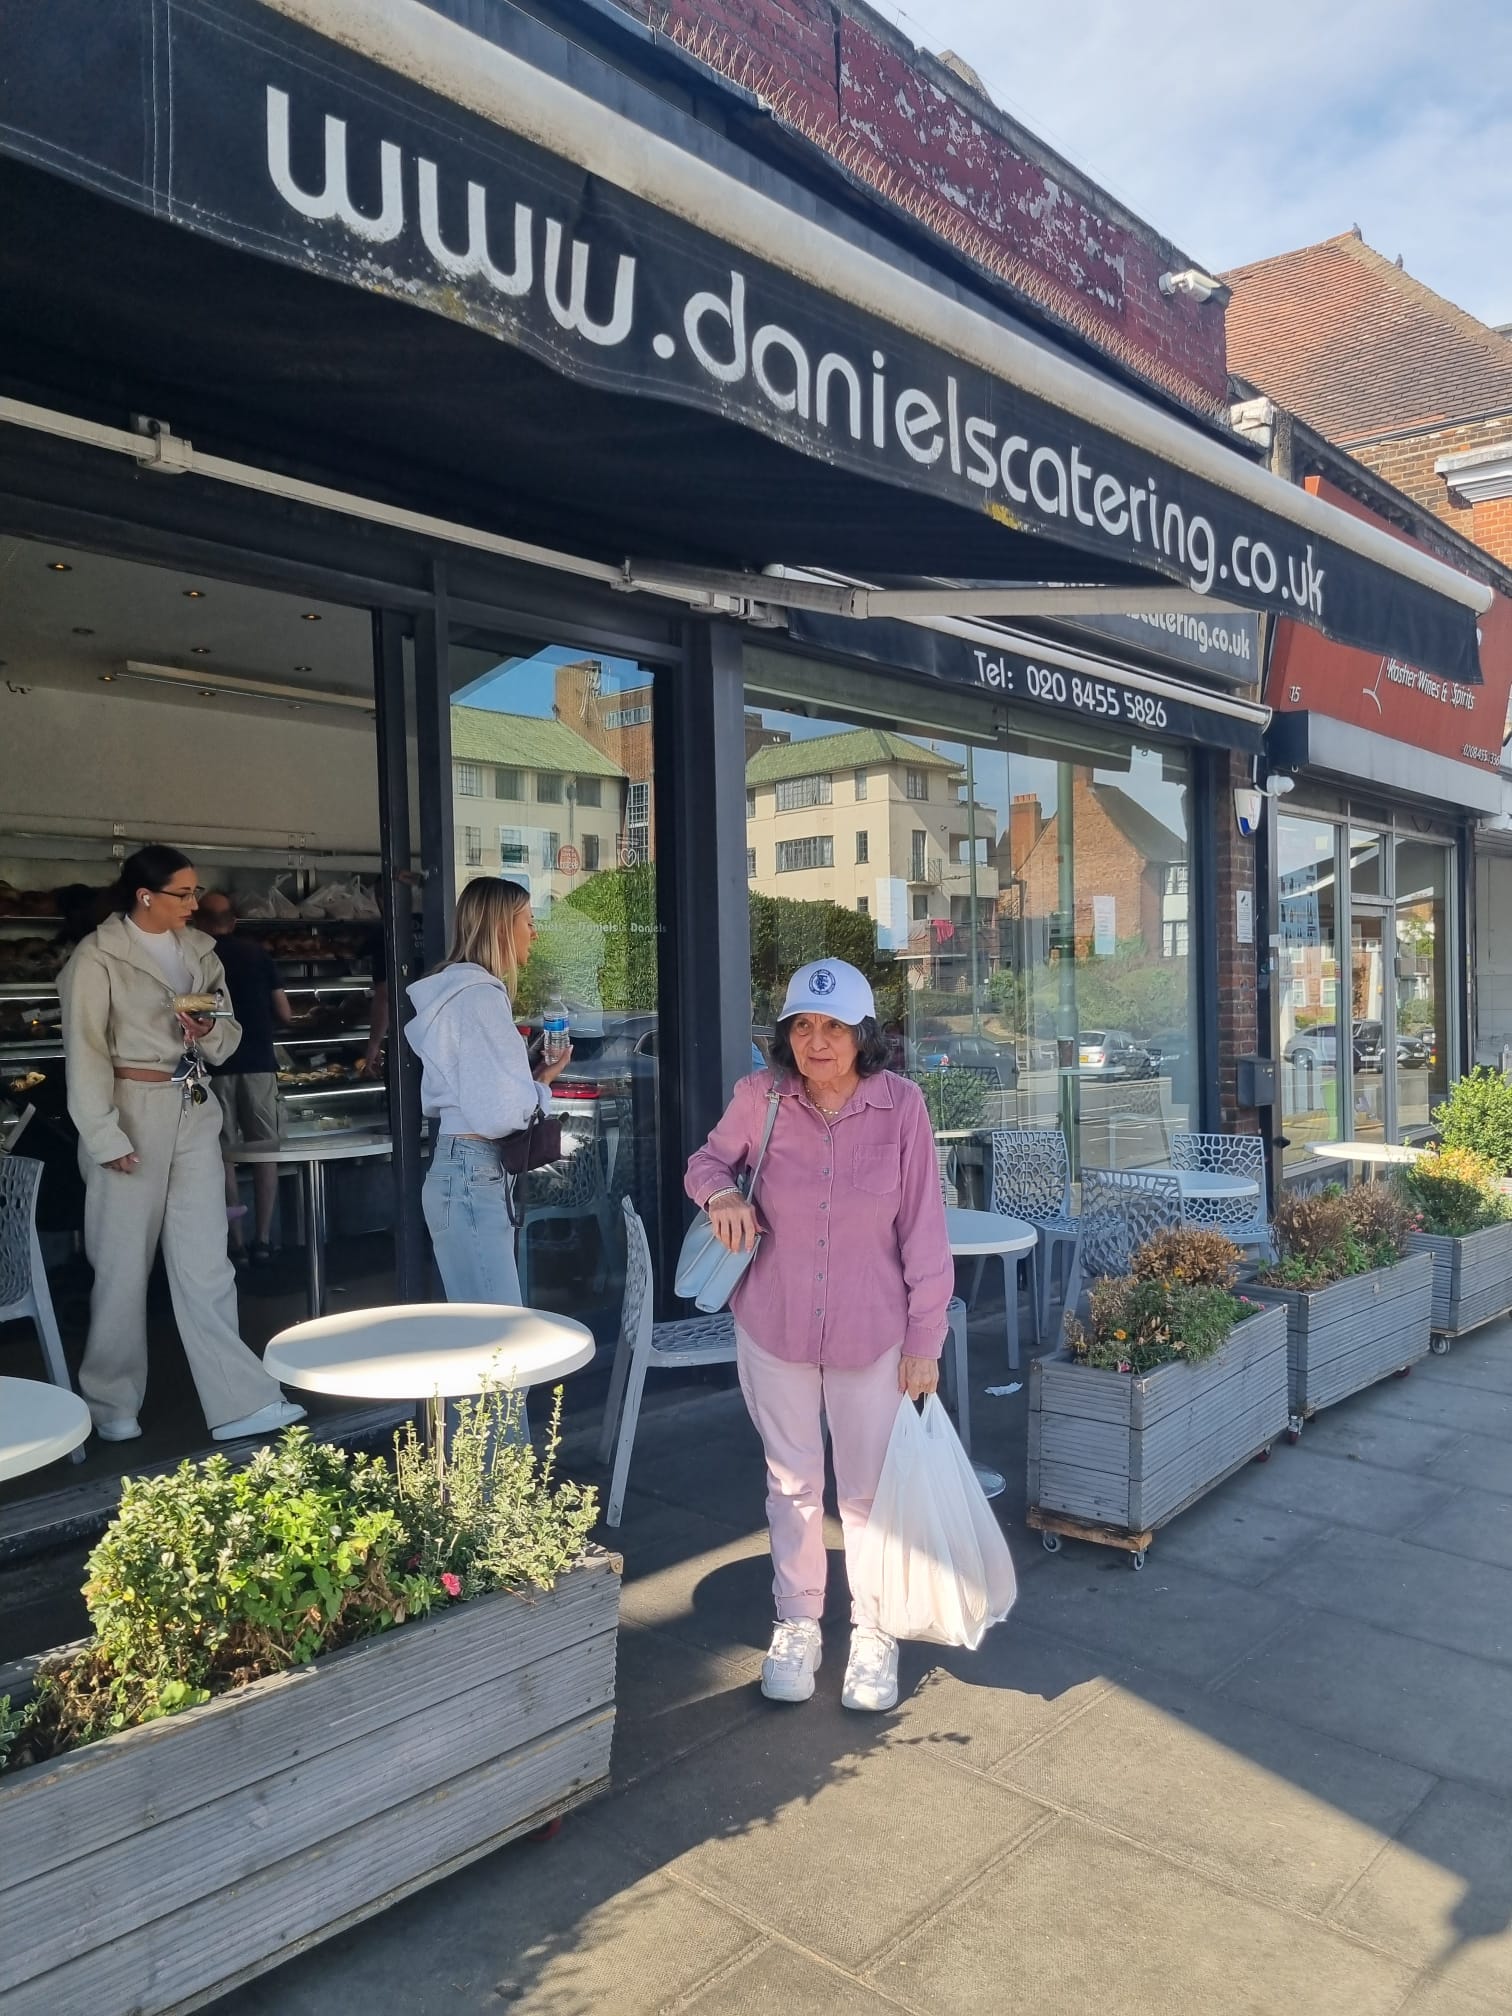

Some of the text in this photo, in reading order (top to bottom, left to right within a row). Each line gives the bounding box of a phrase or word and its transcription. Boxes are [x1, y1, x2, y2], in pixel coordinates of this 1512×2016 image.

[266, 83, 1324, 617] www.danielscatering.co.uk
[973, 650, 1167, 728] Tel: 020 8455 5826
[1387, 657, 1475, 710] Kosher Wines & Spirits
[630, 922, 667, 934] Daniels
